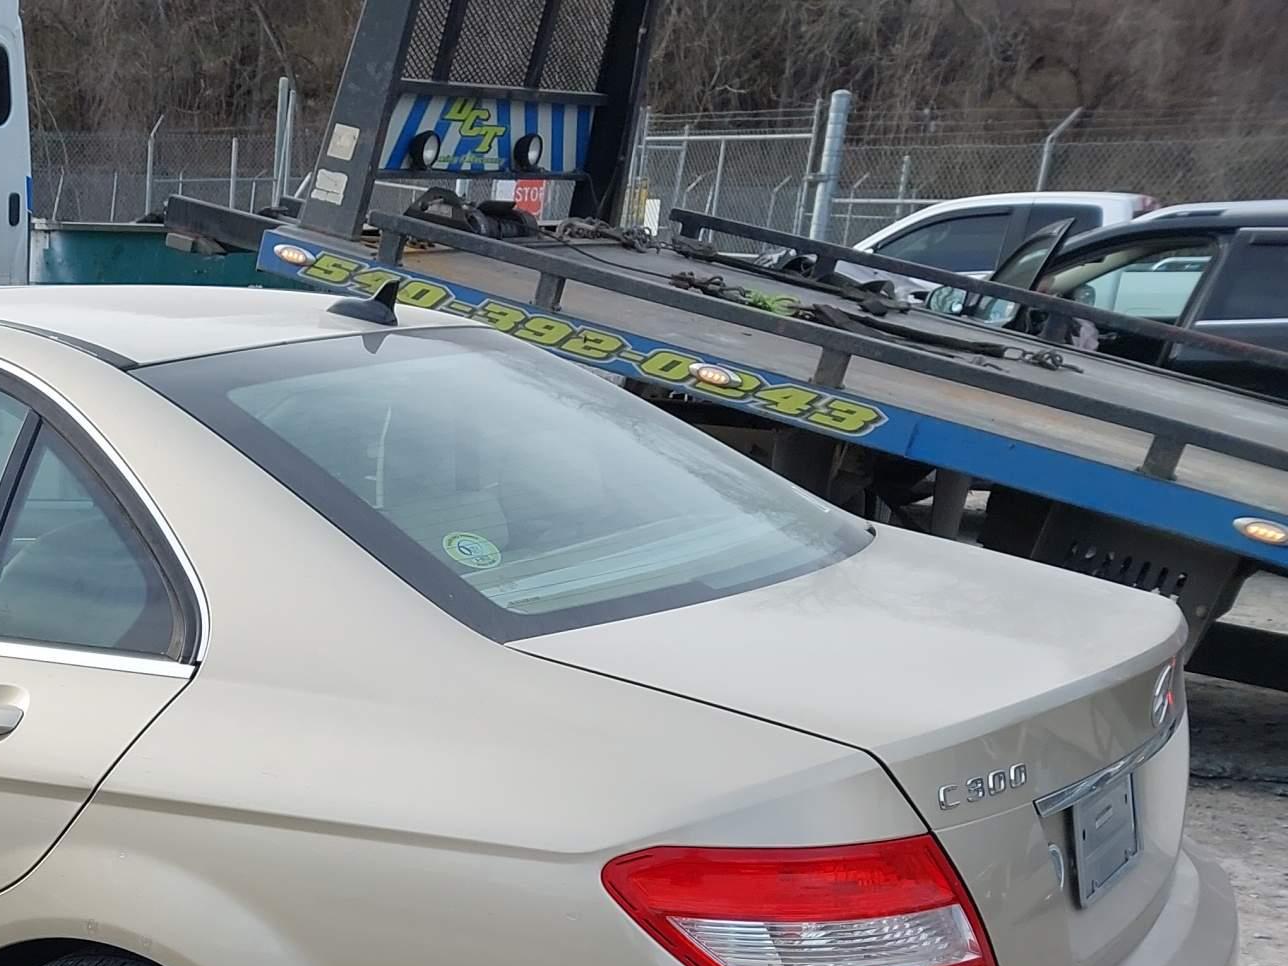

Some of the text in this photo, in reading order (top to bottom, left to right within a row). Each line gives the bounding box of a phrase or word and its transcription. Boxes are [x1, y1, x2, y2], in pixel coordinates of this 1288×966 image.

[443, 97, 507, 153] DCT
[304, 252, 886, 434] 540-392-0243
[938, 762, 1027, 810] C 300
